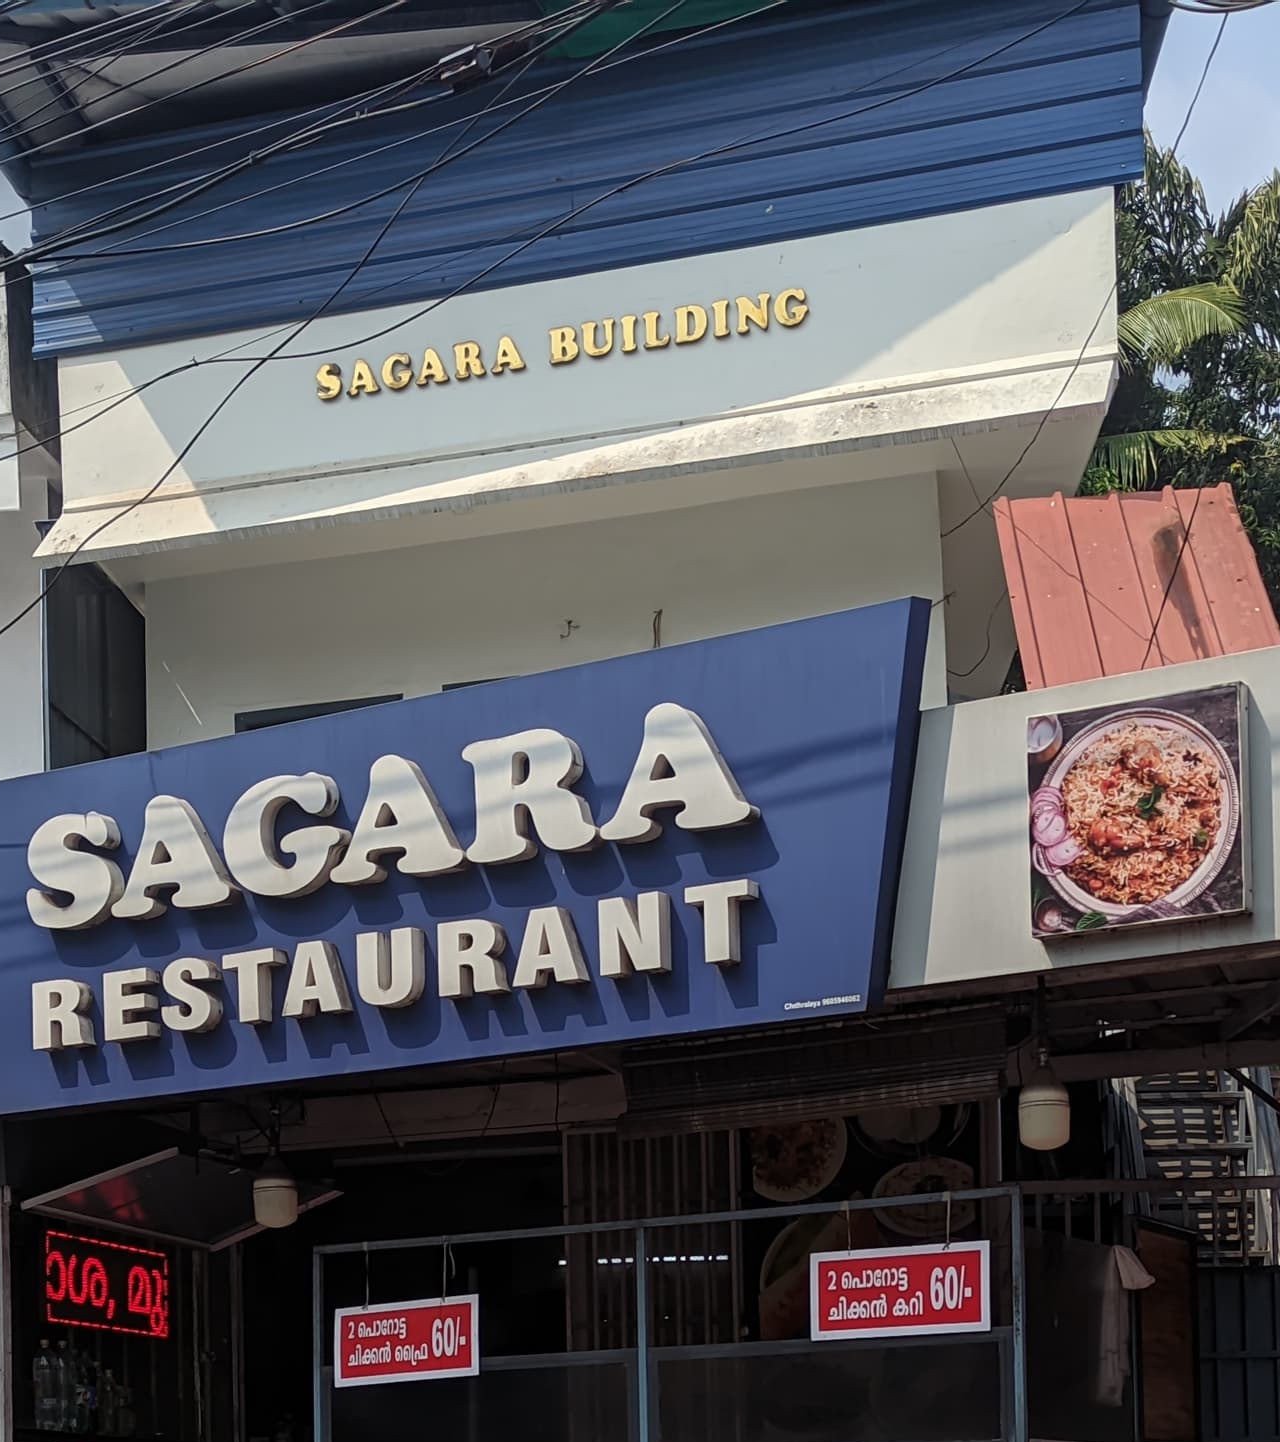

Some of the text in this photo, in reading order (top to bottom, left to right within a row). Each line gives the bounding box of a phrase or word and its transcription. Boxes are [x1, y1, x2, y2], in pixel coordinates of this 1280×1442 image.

[316, 287, 810, 401] SAGARA BUILDING
[25, 701, 761, 930] SAGARA
[31, 878, 761, 1052] RESTAURANT
[827, 1267, 908, 1291] 2 പൊറോട്ട
[930, 1265, 972, 1311] 60/-
[827, 1291, 924, 1321] ചിക്കൻ കറി
[348, 1317, 407, 1340] 2 പൊറോട്ട
[431, 1316, 466, 1358] 60/-
[348, 1341, 392, 1367] ചിക്കൻ
